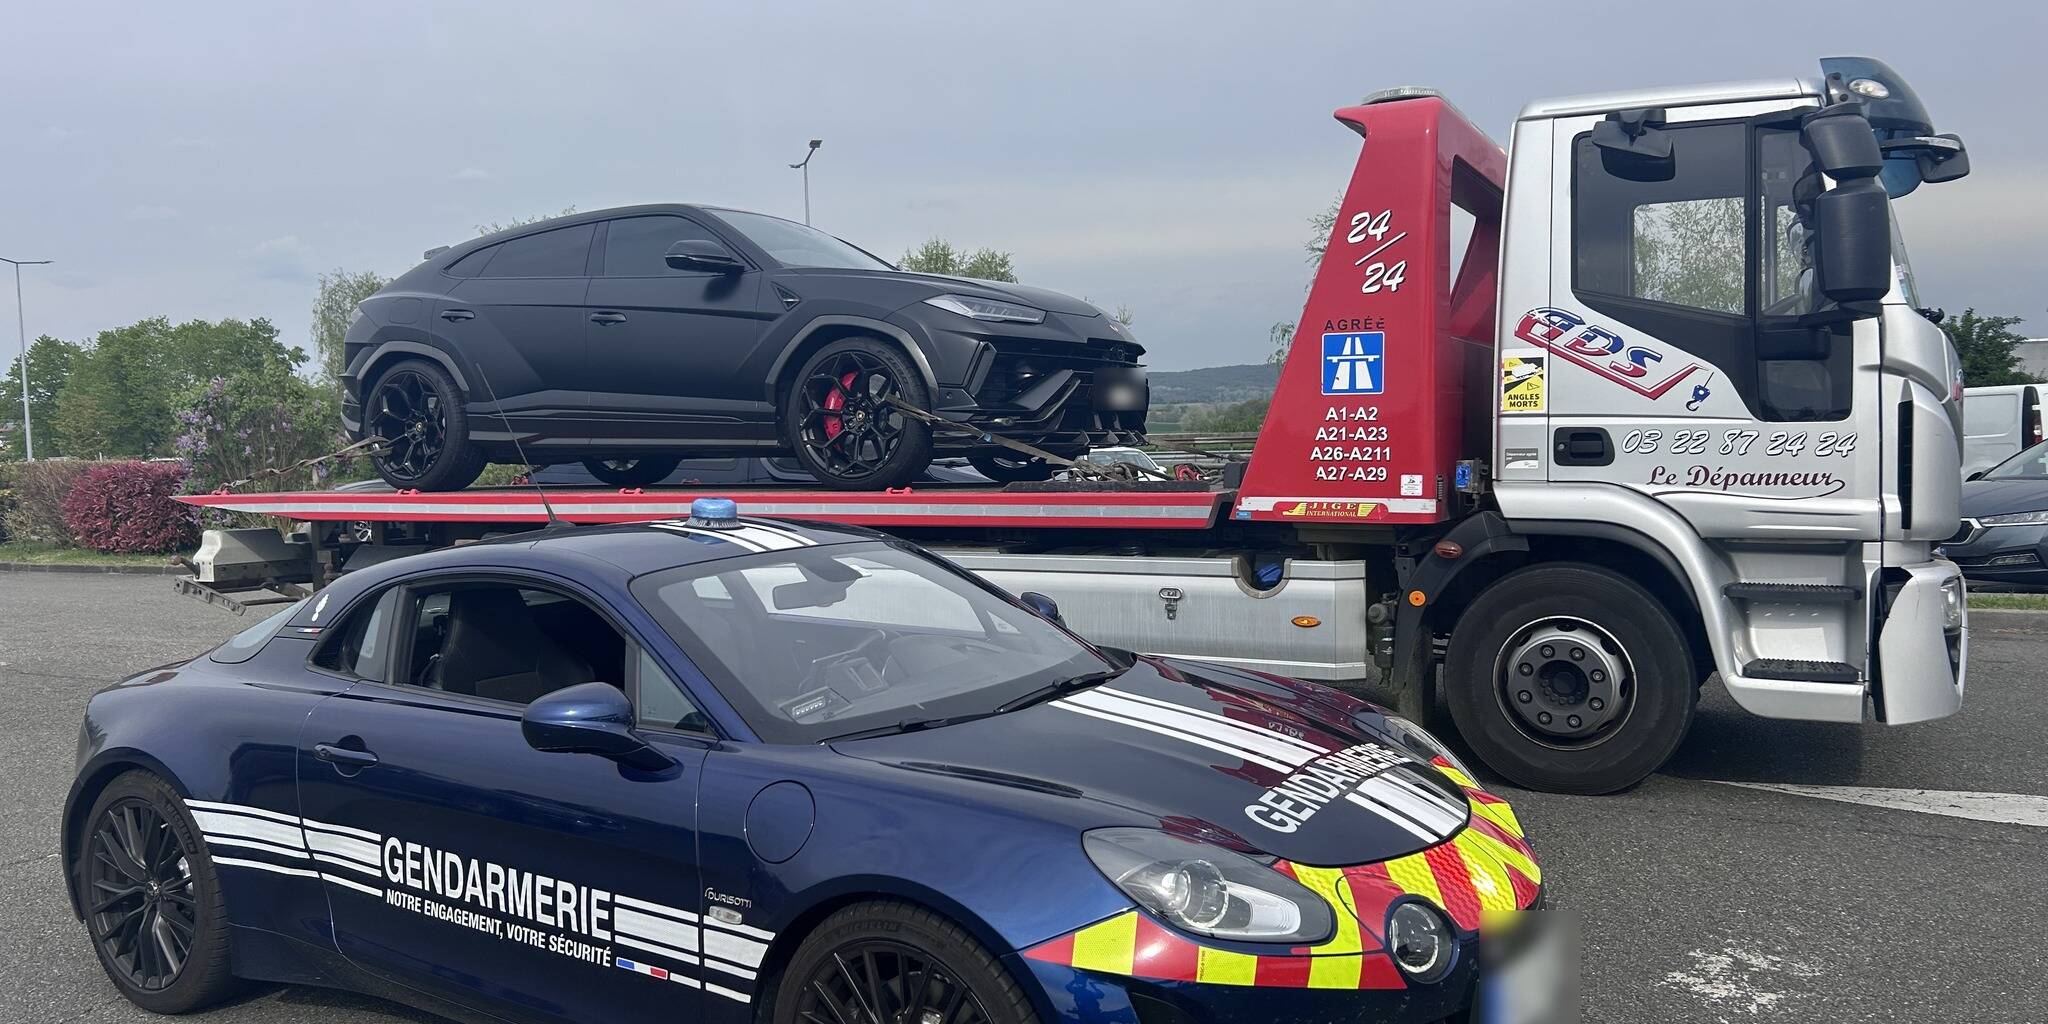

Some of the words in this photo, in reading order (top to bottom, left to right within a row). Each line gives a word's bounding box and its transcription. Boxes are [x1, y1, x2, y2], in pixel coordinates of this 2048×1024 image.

[1347, 210, 1391, 243] 24
[1362, 260, 1407, 293] 24
[1507, 393, 1540, 401] ANGLES
[1509, 400, 1539, 408] MORTS
[1325, 406, 1378, 421] A1-A2
[1315, 426, 1388, 441] A21-A23
[1622, 429, 1662, 454] 03
[1670, 430, 1709, 455] 22
[1719, 430, 1759, 456] 87
[1766, 431, 1807, 457] 24
[1815, 431, 1857, 458] 24
[1310, 446, 1391, 461] A26-A211
[1316, 466, 1387, 481] A27-A29
[1647, 465, 1677, 486] Le
[1686, 464, 1845, 492] Dépanneur
[1309, 502, 1357, 510] JIGE
[1244, 742, 1412, 834] GENDARMERIE
[383, 836, 612, 942] GENDARMERIE
[386, 889, 423, 914] NOTRE
[424, 901, 503, 940] ENGAGEMENT,
[506, 922, 546, 950] VOTRE
[548, 932, 612, 968] SÉCURITÉ
